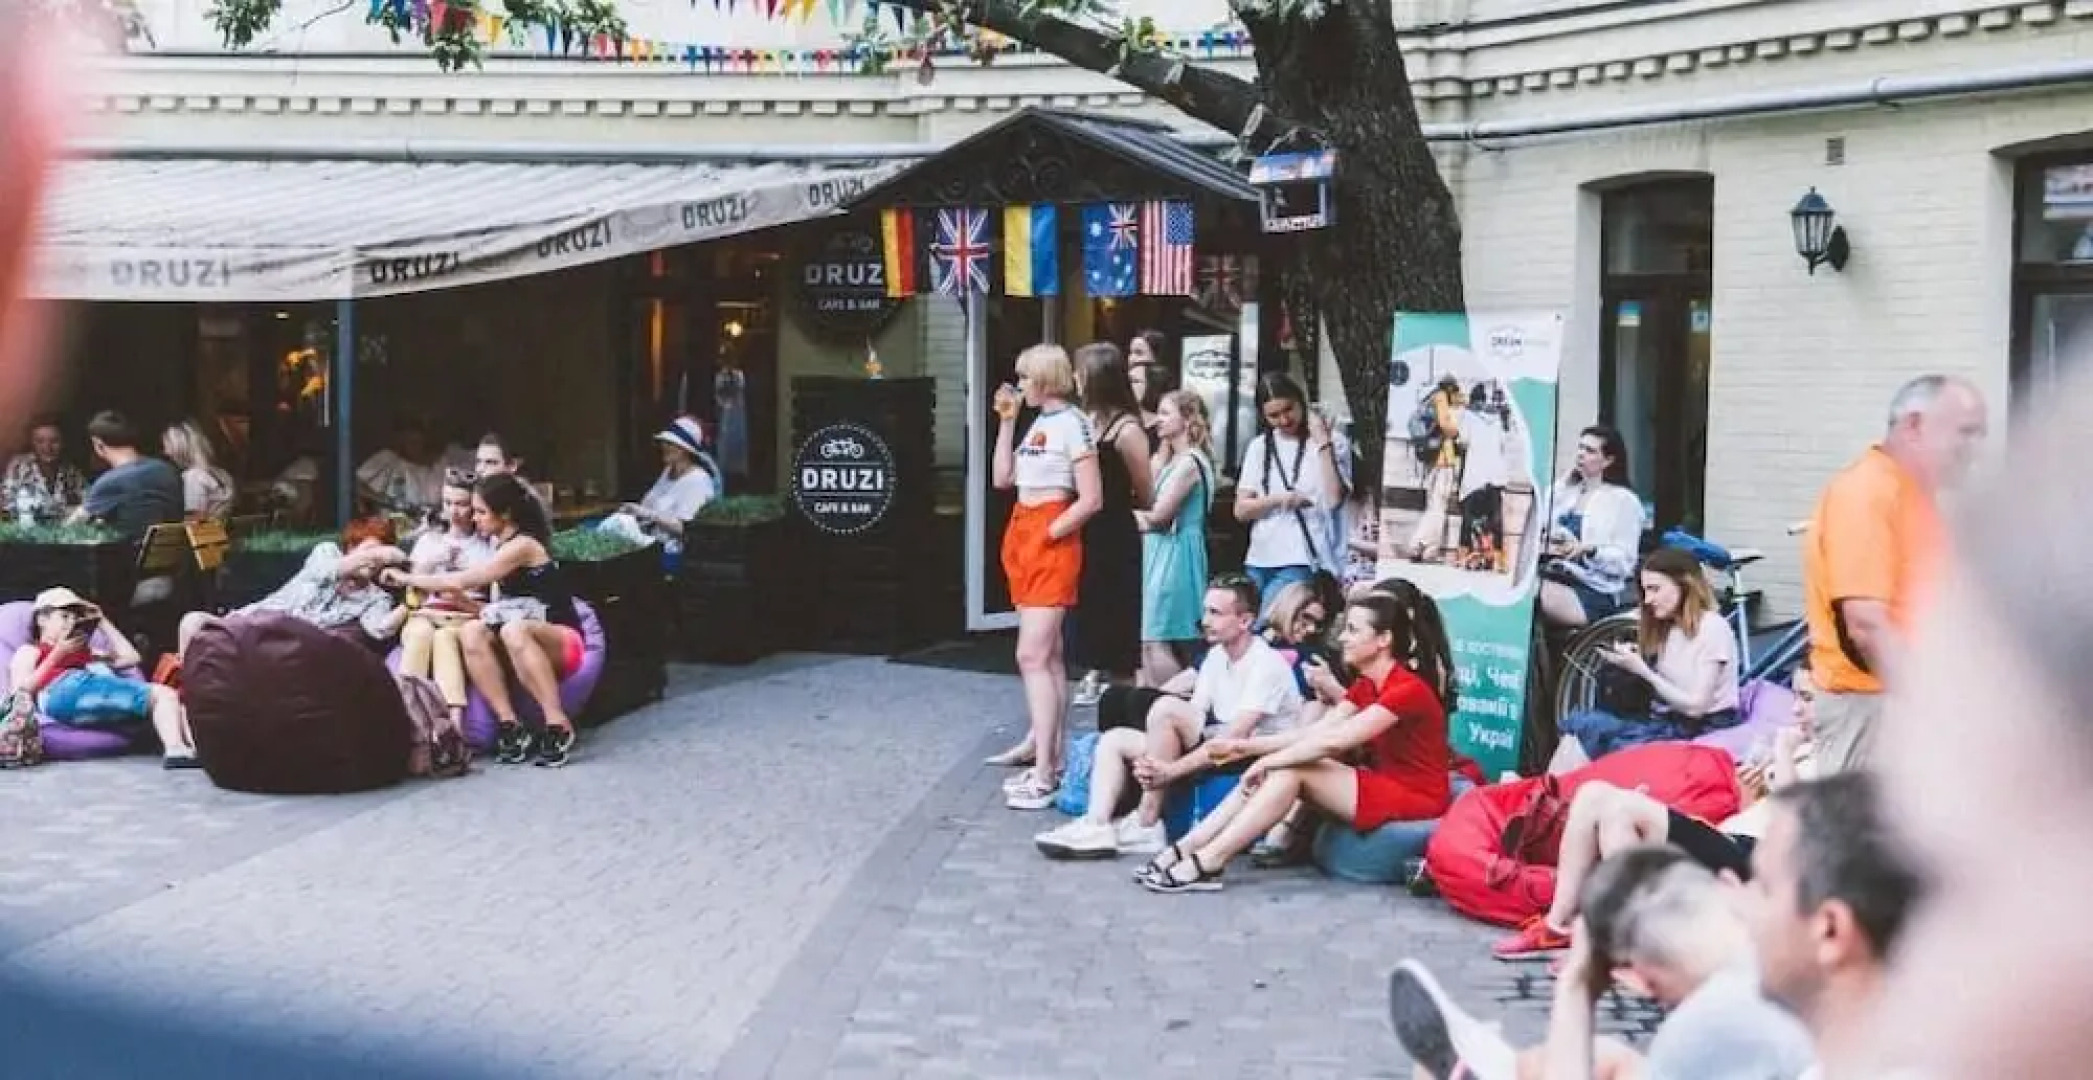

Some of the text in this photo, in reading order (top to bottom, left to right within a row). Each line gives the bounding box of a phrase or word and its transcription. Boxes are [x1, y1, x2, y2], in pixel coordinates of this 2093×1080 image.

[682, 194, 747, 230] DRUZI
[537, 216, 613, 259] DRUZI
[110, 258, 231, 288] DRUZI
[371, 250, 460, 284] DRUZI
[804, 262, 884, 286] DRUZ
[802, 467, 885, 491] DRUZI
[813, 501, 839, 514] CAFE
[851, 501, 872, 514] BAR
